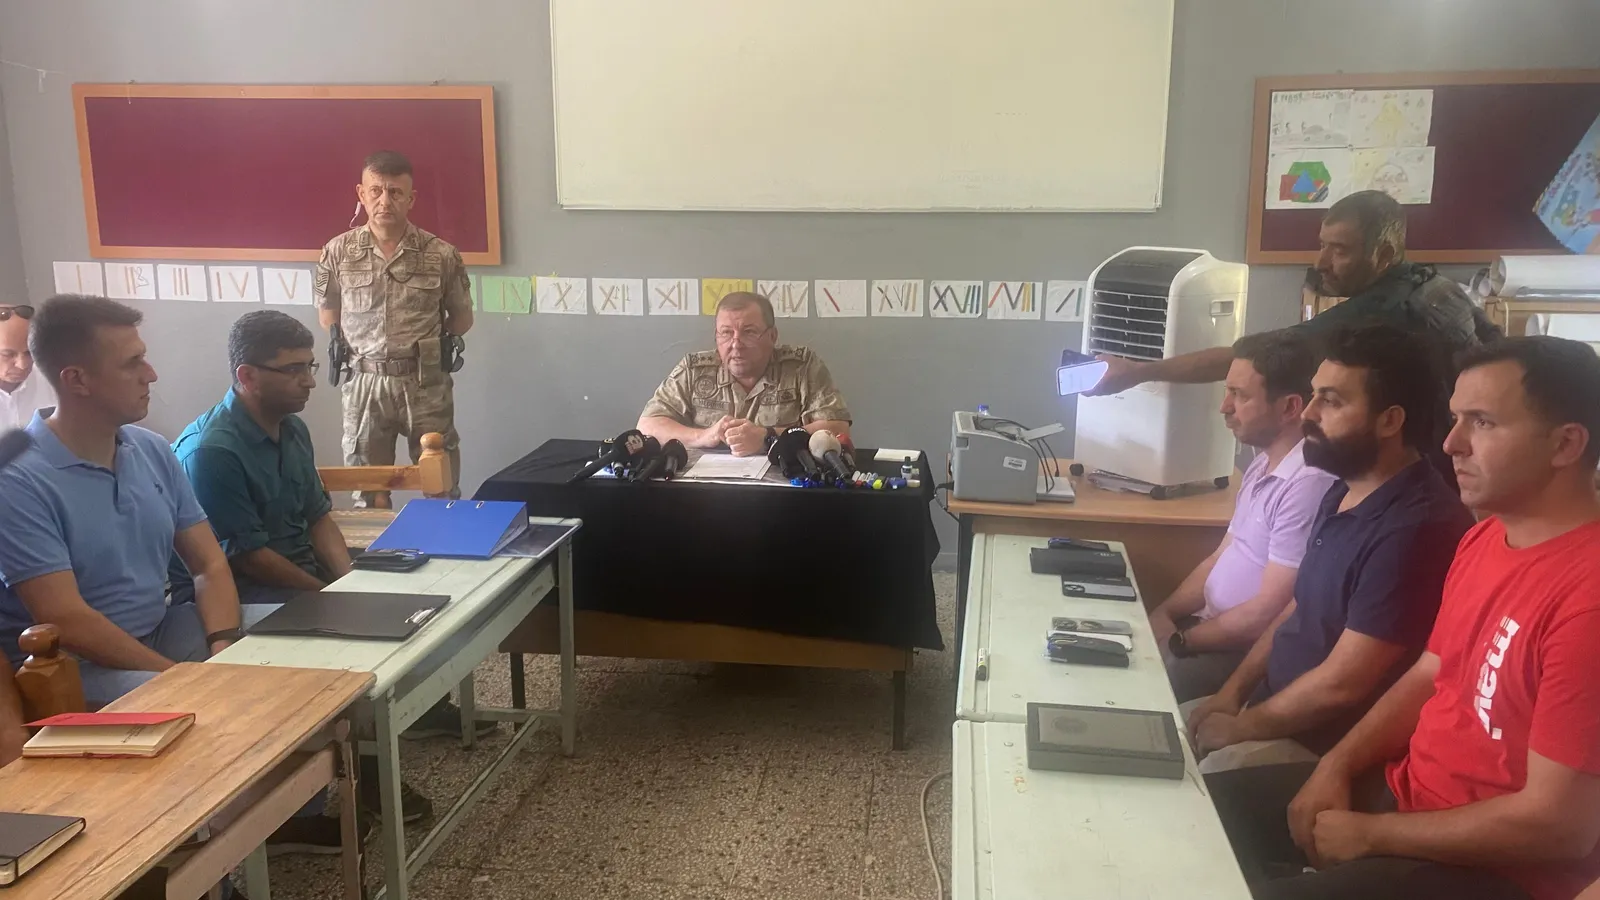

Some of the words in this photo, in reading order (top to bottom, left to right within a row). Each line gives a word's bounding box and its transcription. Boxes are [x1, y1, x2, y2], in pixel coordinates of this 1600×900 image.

[173, 267, 190, 296] III
[216, 271, 250, 300] IV
[278, 271, 299, 300] V
[654, 281, 689, 311] XII
